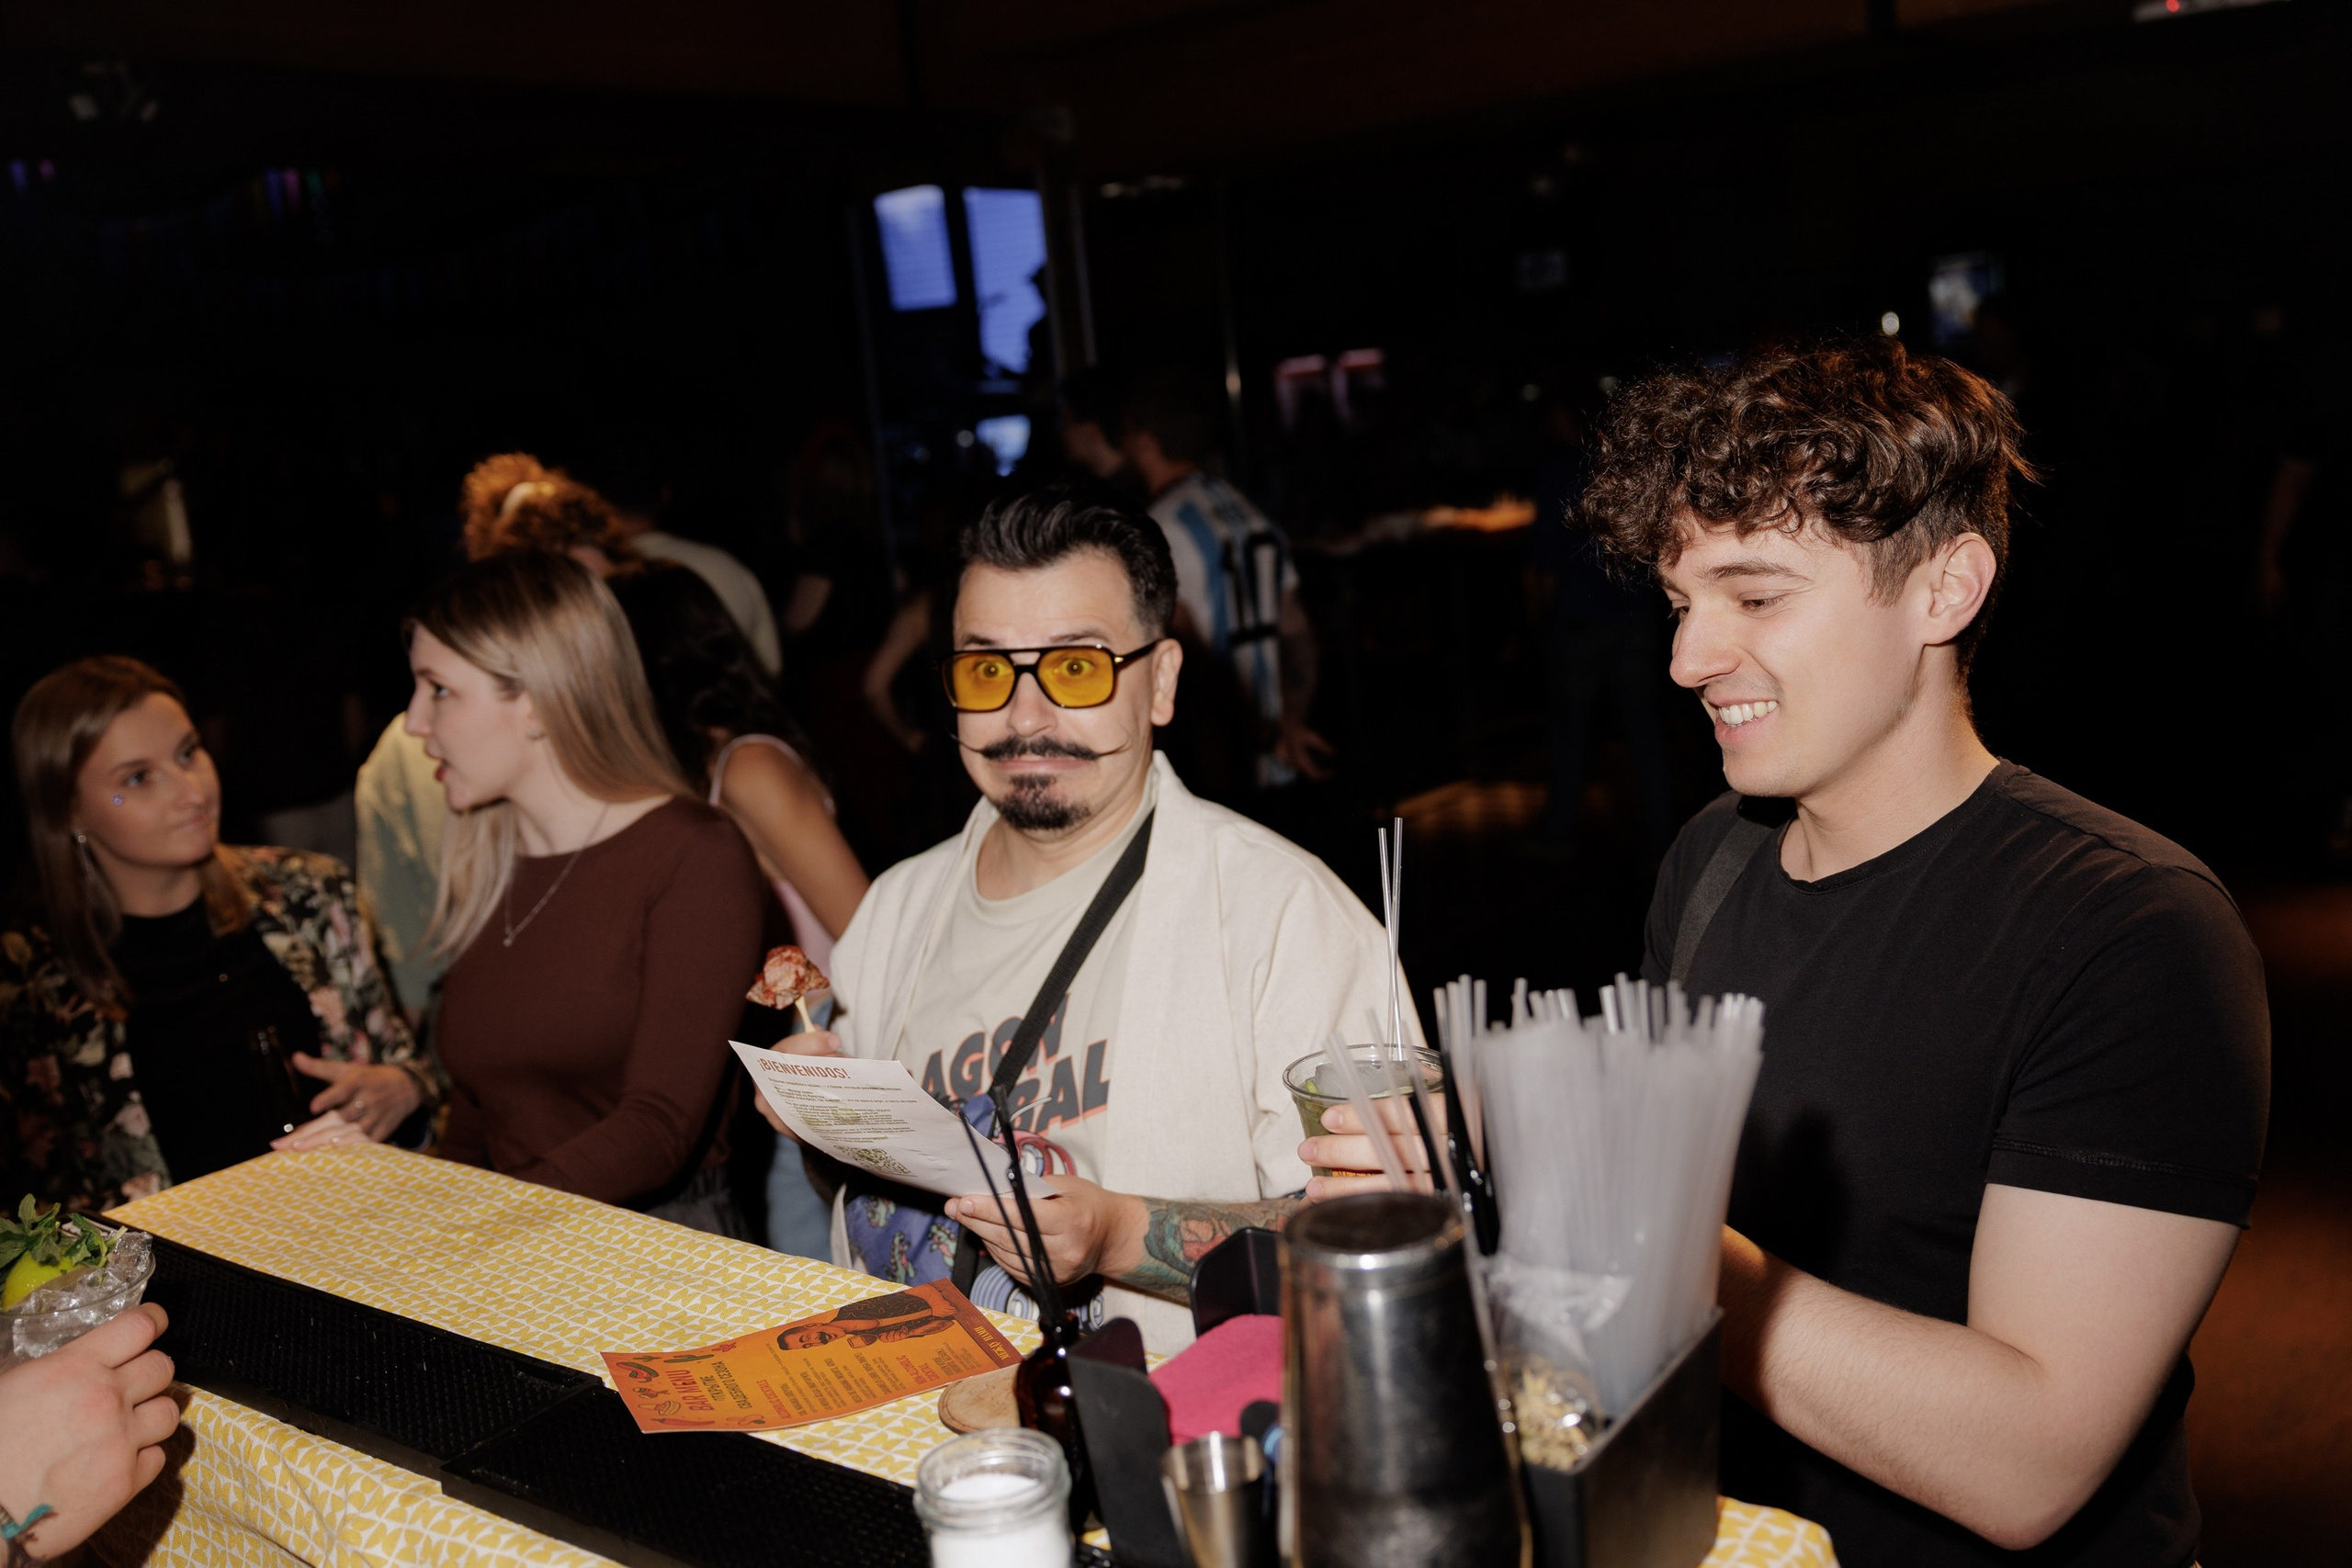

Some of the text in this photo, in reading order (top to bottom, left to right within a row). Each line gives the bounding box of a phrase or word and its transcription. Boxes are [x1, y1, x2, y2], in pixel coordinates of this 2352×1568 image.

[1220, 534, 1286, 643] 10
[757, 1057, 853, 1080] ¡BIENVENIDOS!
[664, 1370, 715, 1411] BAR MENU
